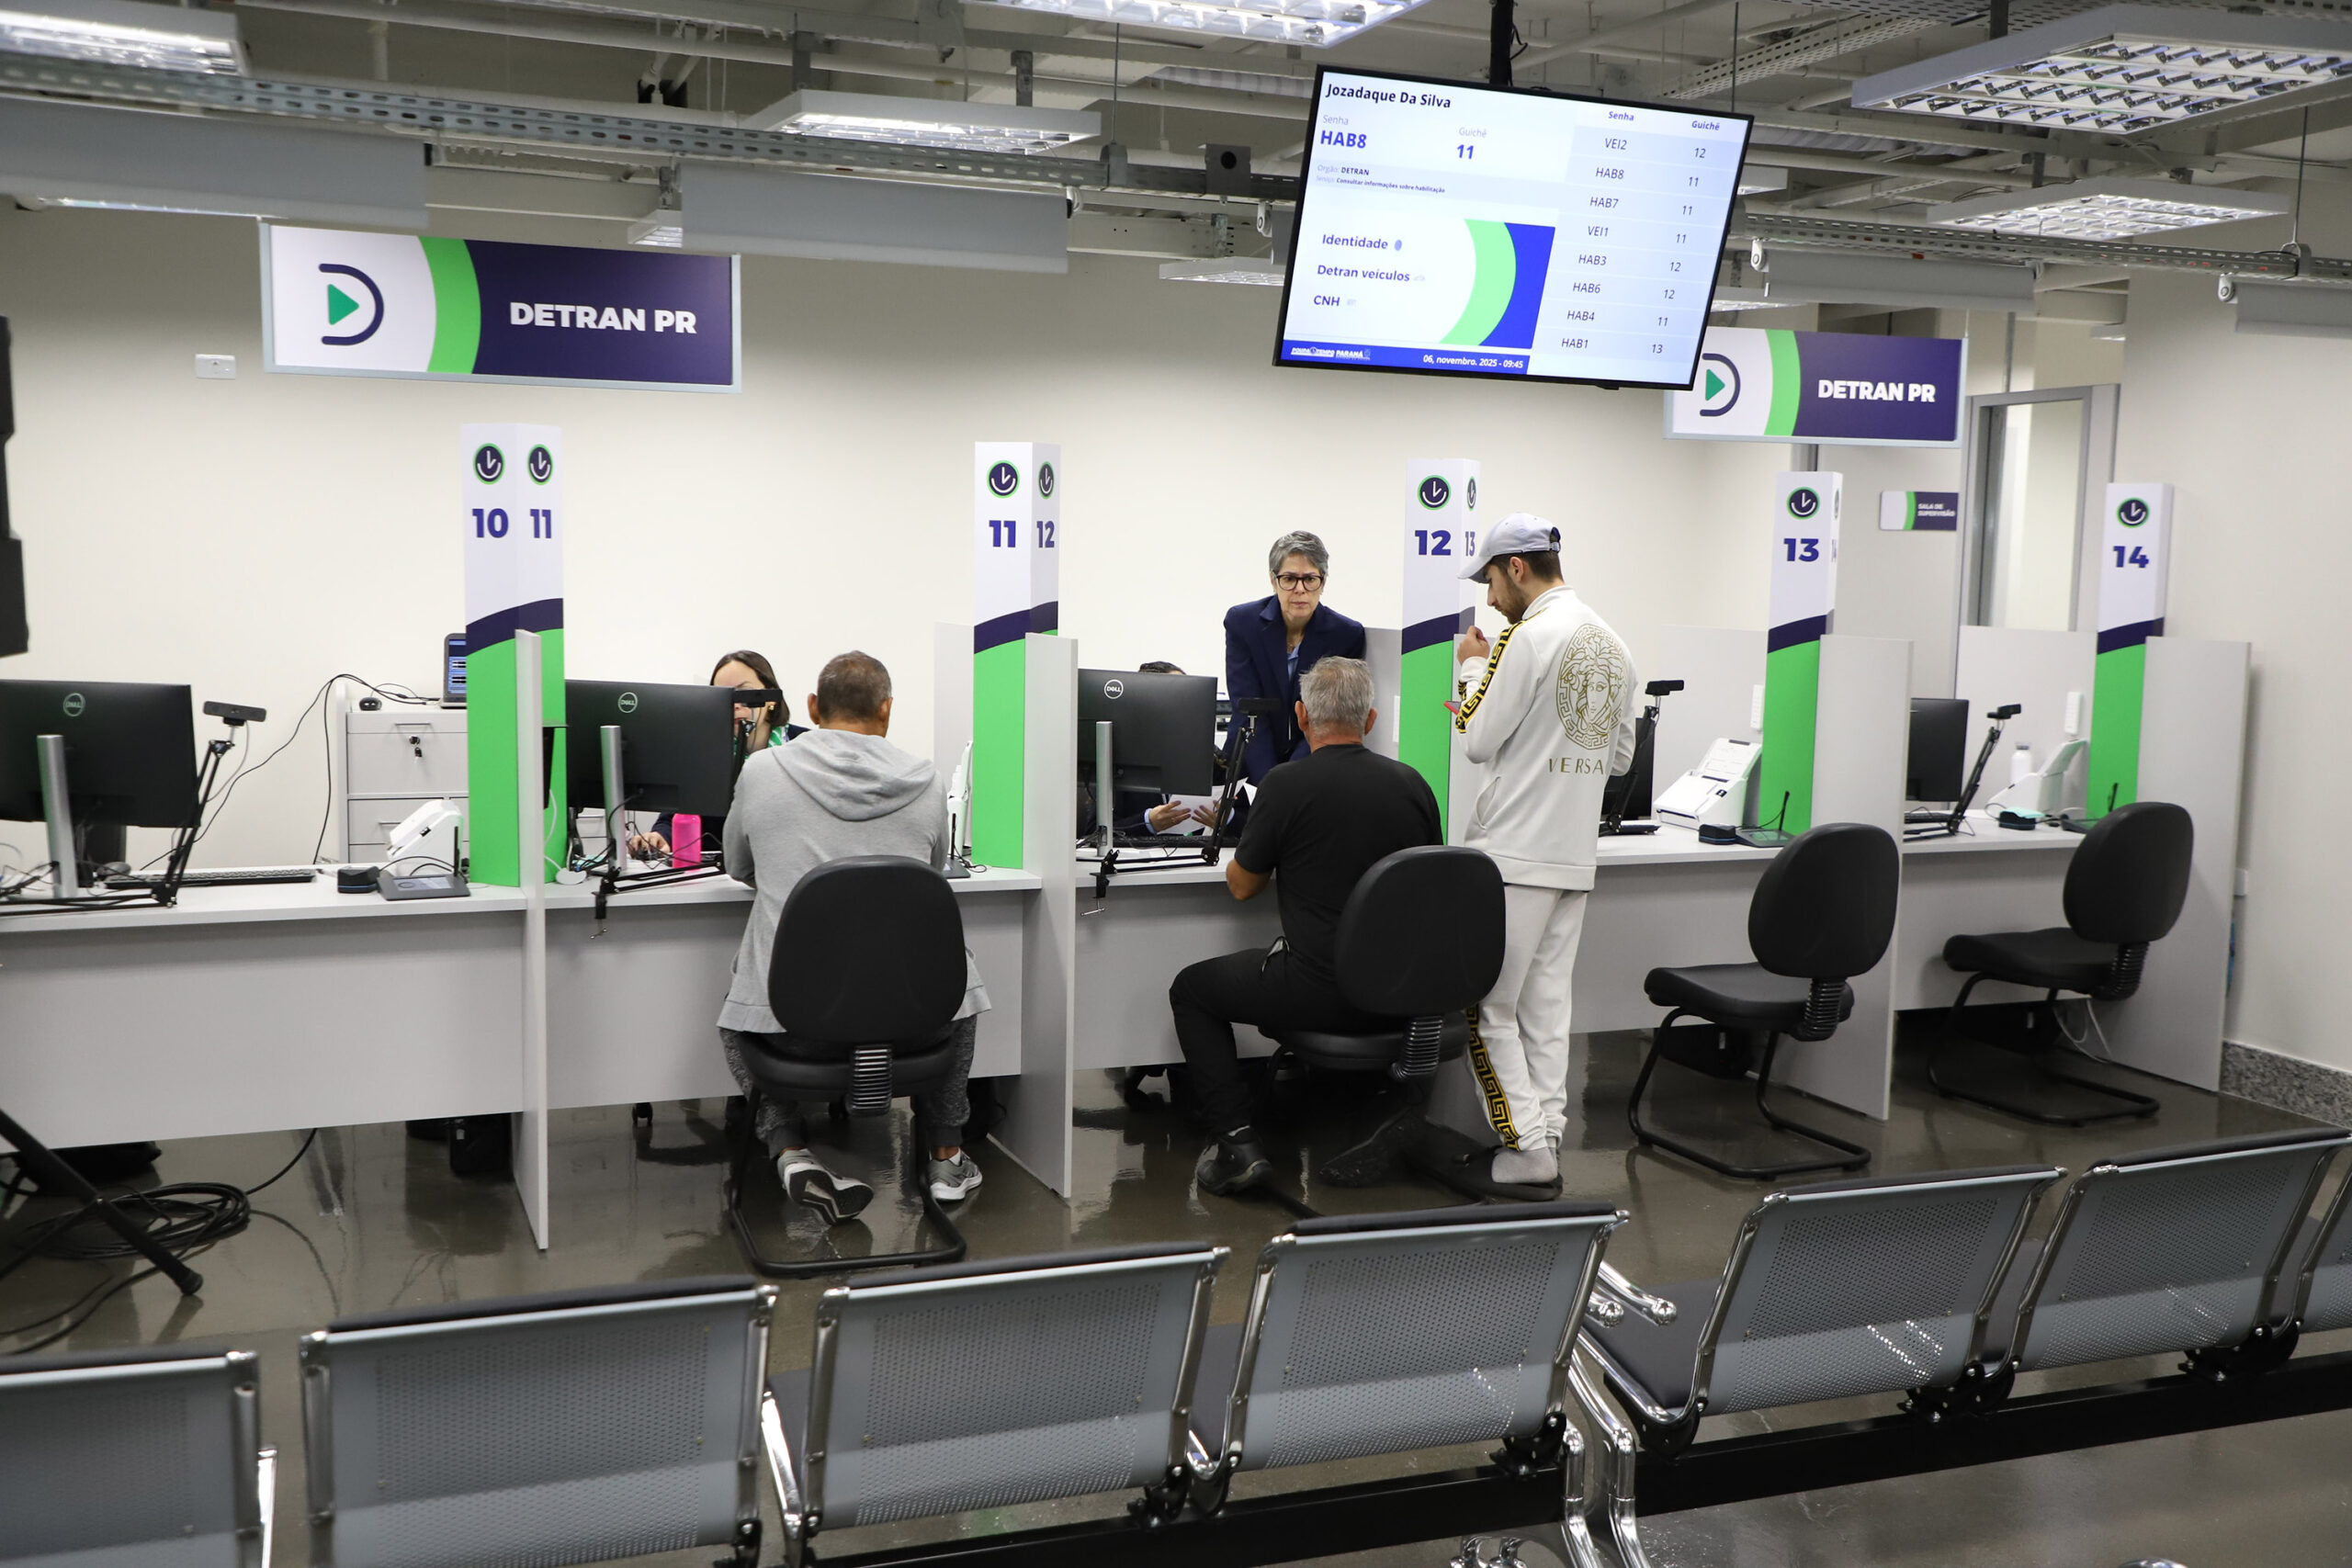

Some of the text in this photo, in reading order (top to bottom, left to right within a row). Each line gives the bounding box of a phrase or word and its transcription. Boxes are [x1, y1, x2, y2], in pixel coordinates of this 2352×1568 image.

[1325, 84, 1452, 108] Jozadaque Da Silva
[1322, 114, 1350, 126] Senha
[1608, 110, 1634, 121] Senha
[1458, 127, 1487, 139] Guichê
[1690, 120, 1721, 131] Guichê
[1319, 130, 1368, 149] HAB8
[1604, 137, 1706, 159] VEI2 12
[1456, 143, 1475, 160] 11
[1340, 166, 1370, 176] DETRAN
[1595, 166, 1700, 187] HAB8 11
[1336, 177, 1363, 186] Consultar
[1364, 179, 1398, 189] informações
[1589, 196, 1693, 216] HAB7 11
[1322, 233, 1389, 250] Identidade
[1587, 225, 1687, 244] VEI1 11
[1577, 254, 1681, 273] HAB3 12
[1317, 264, 1410, 283] Detran veículos
[1572, 282, 1675, 299] HAB6 12
[1313, 295, 1340, 307] CNH
[510, 301, 697, 334] DETRAN PR
[1566, 310, 1668, 327] HAB4 11
[1561, 337, 1663, 355] HAB1 13
[1423, 355, 1434, 365] 06,
[1436, 355, 1477, 366] novembro.
[1479, 357, 1498, 368] 2025
[1503, 358, 1524, 369] 09:45
[1817, 378, 1936, 403] DETRAN PR
[471, 507, 509, 539] 10
[529, 508, 553, 539] 11
[989, 520, 1016, 548] 11
[1036, 520, 1055, 548] 12
[1415, 530, 1452, 556] 12
[1464, 531, 1476, 557] 13
[1783, 537, 1819, 562] 13
[2113, 545, 2150, 569] 14
